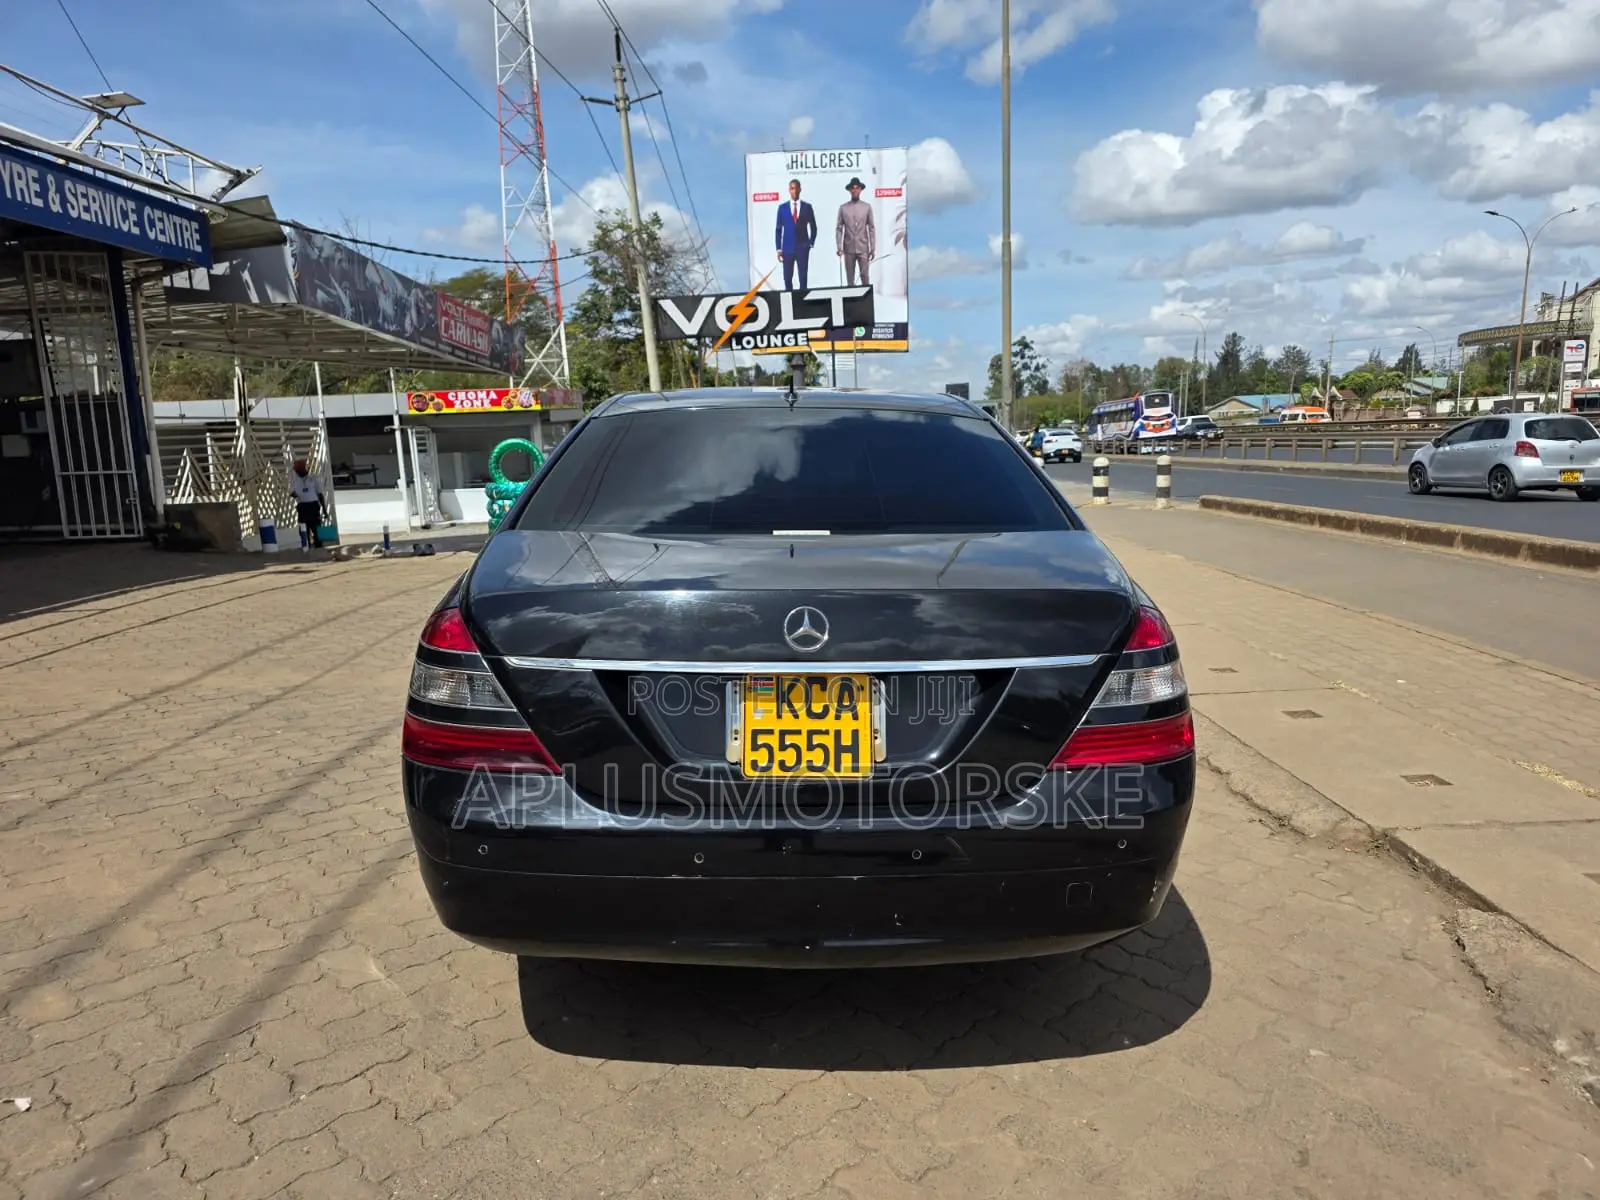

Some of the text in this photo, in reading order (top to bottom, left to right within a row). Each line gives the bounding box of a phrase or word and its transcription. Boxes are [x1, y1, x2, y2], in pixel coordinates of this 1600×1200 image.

[790, 152, 862, 170] HILLCREST
[47, 173, 62, 214] &
[64, 179, 140, 235] SERVICE
[143, 205, 202, 253] CENTRE
[658, 286, 871, 336] VOLT
[441, 316, 489, 352] CARWASH
[731, 332, 808, 350] LOUNGE
[448, 390, 498, 401] CHOMA
[454, 399, 492, 409] ZONE
[776, 676, 859, 720] KCA
[750, 728, 860, 773] 555H
